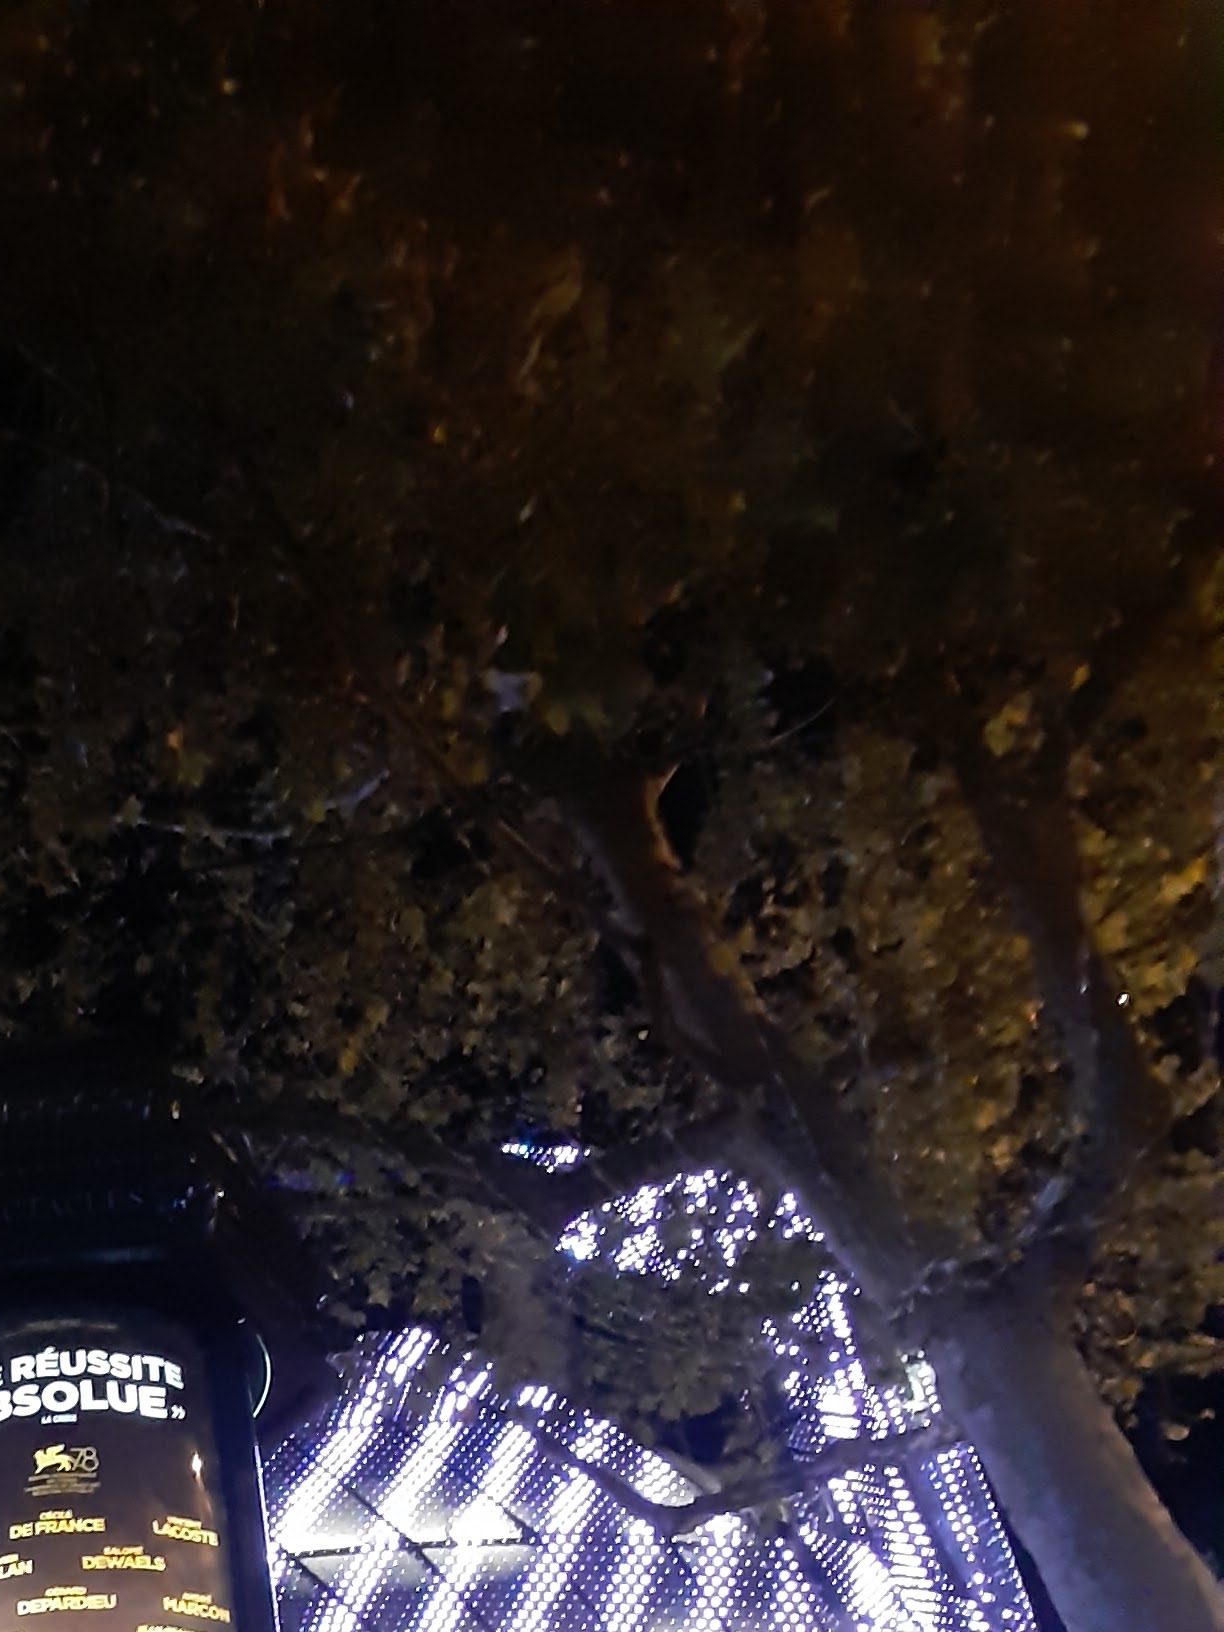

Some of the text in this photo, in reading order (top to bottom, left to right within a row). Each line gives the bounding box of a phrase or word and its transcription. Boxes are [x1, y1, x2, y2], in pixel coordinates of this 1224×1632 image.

[10, 1346, 185, 1390] RÉUSSITE
[70, 1446, 100, 1472] 78
[9, 1518, 106, 1540] DE FRANCE
[152, 1519, 219, 1547] LACOSTE
[81, 1554, 167, 1572] DEWAELS
[17, 1593, 118, 1616] DEPARDIEU
